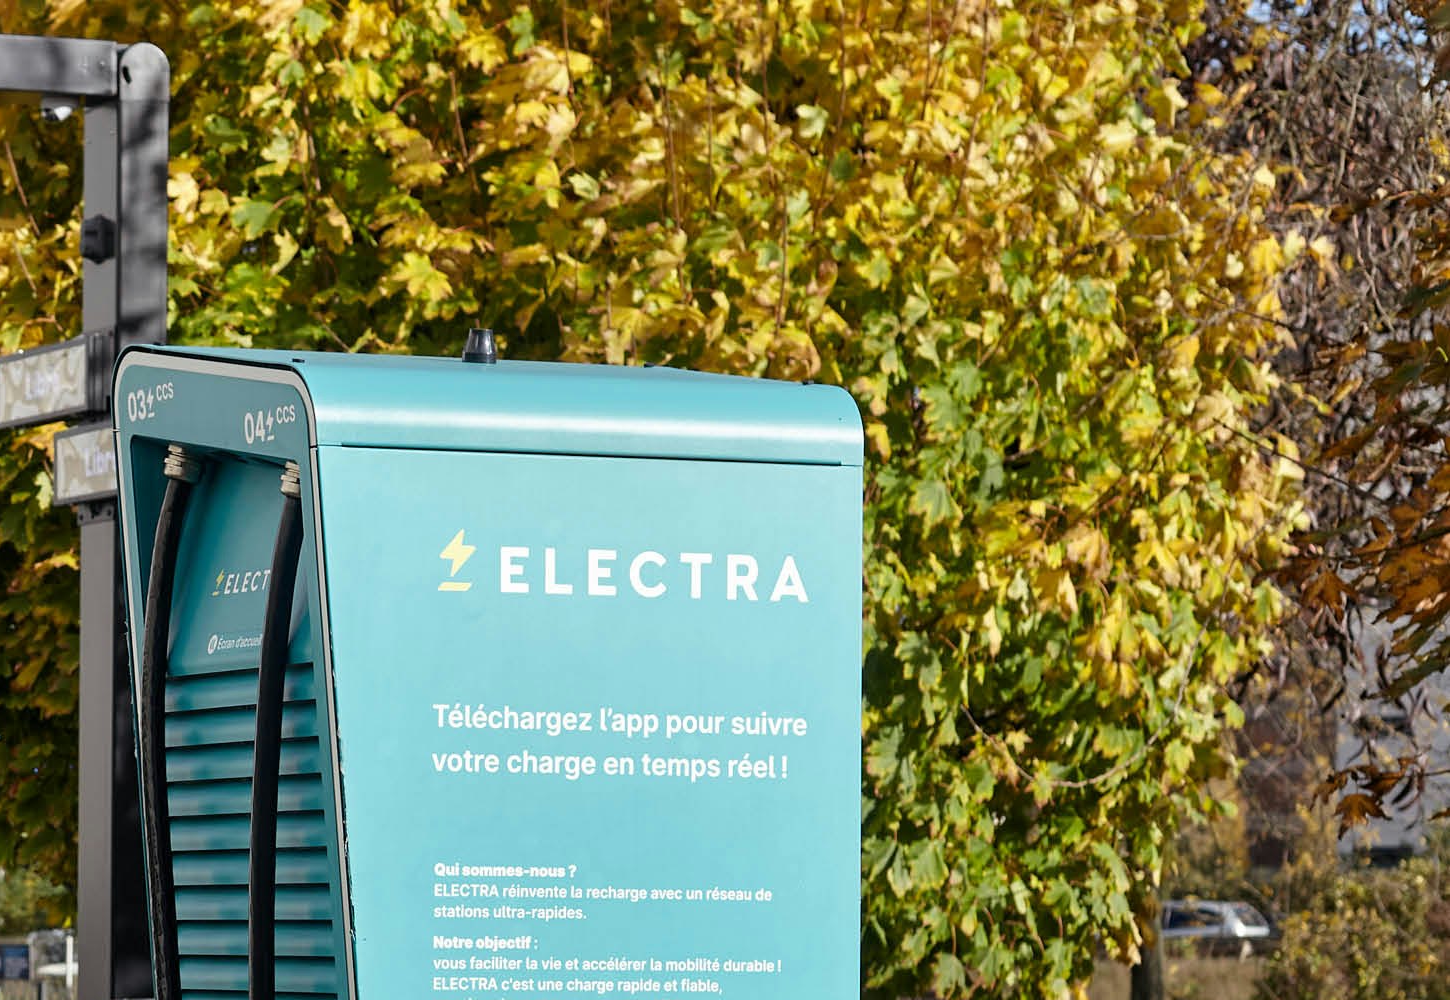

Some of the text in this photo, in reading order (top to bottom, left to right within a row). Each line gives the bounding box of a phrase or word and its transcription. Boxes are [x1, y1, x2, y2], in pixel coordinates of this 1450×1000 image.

[127, 382, 174, 422] 03 CCS
[244, 404, 296, 444] 04 CCS
[224, 569, 270, 594] ELECT
[500, 546, 808, 603] ELECTRA
[433, 703, 807, 738] Téléchargez l’app pour suivre
[432, 750, 500, 773] votre
[506, 750, 596, 780] charge
[603, 757, 634, 776] en
[641, 754, 721, 783] temps
[728, 753, 776, 778] réel
[434, 862, 460, 877] Qui
[462, 866, 566, 878] sommes-nous
[434, 883, 773, 903] ELECTRA réinvente la recharge avec un réseau de
[434, 904, 587, 922] stations ultra-rapides.
[433, 935, 474, 949] Notre
[475, 935, 532, 952] objectif
[433, 959, 467, 970] vous
[470, 956, 523, 970] faciliter
[525, 956, 538, 970] la
[541, 956, 562, 970] vie
[564, 958, 579, 971] et
[582, 957, 647, 971] accélérer
[650, 958, 663, 972] la
[665, 958, 720, 972] mobilité
[723, 959, 775, 973] durable
[432, 976, 723, 995] ELECTRA c'est une charge rapide et fiable,
